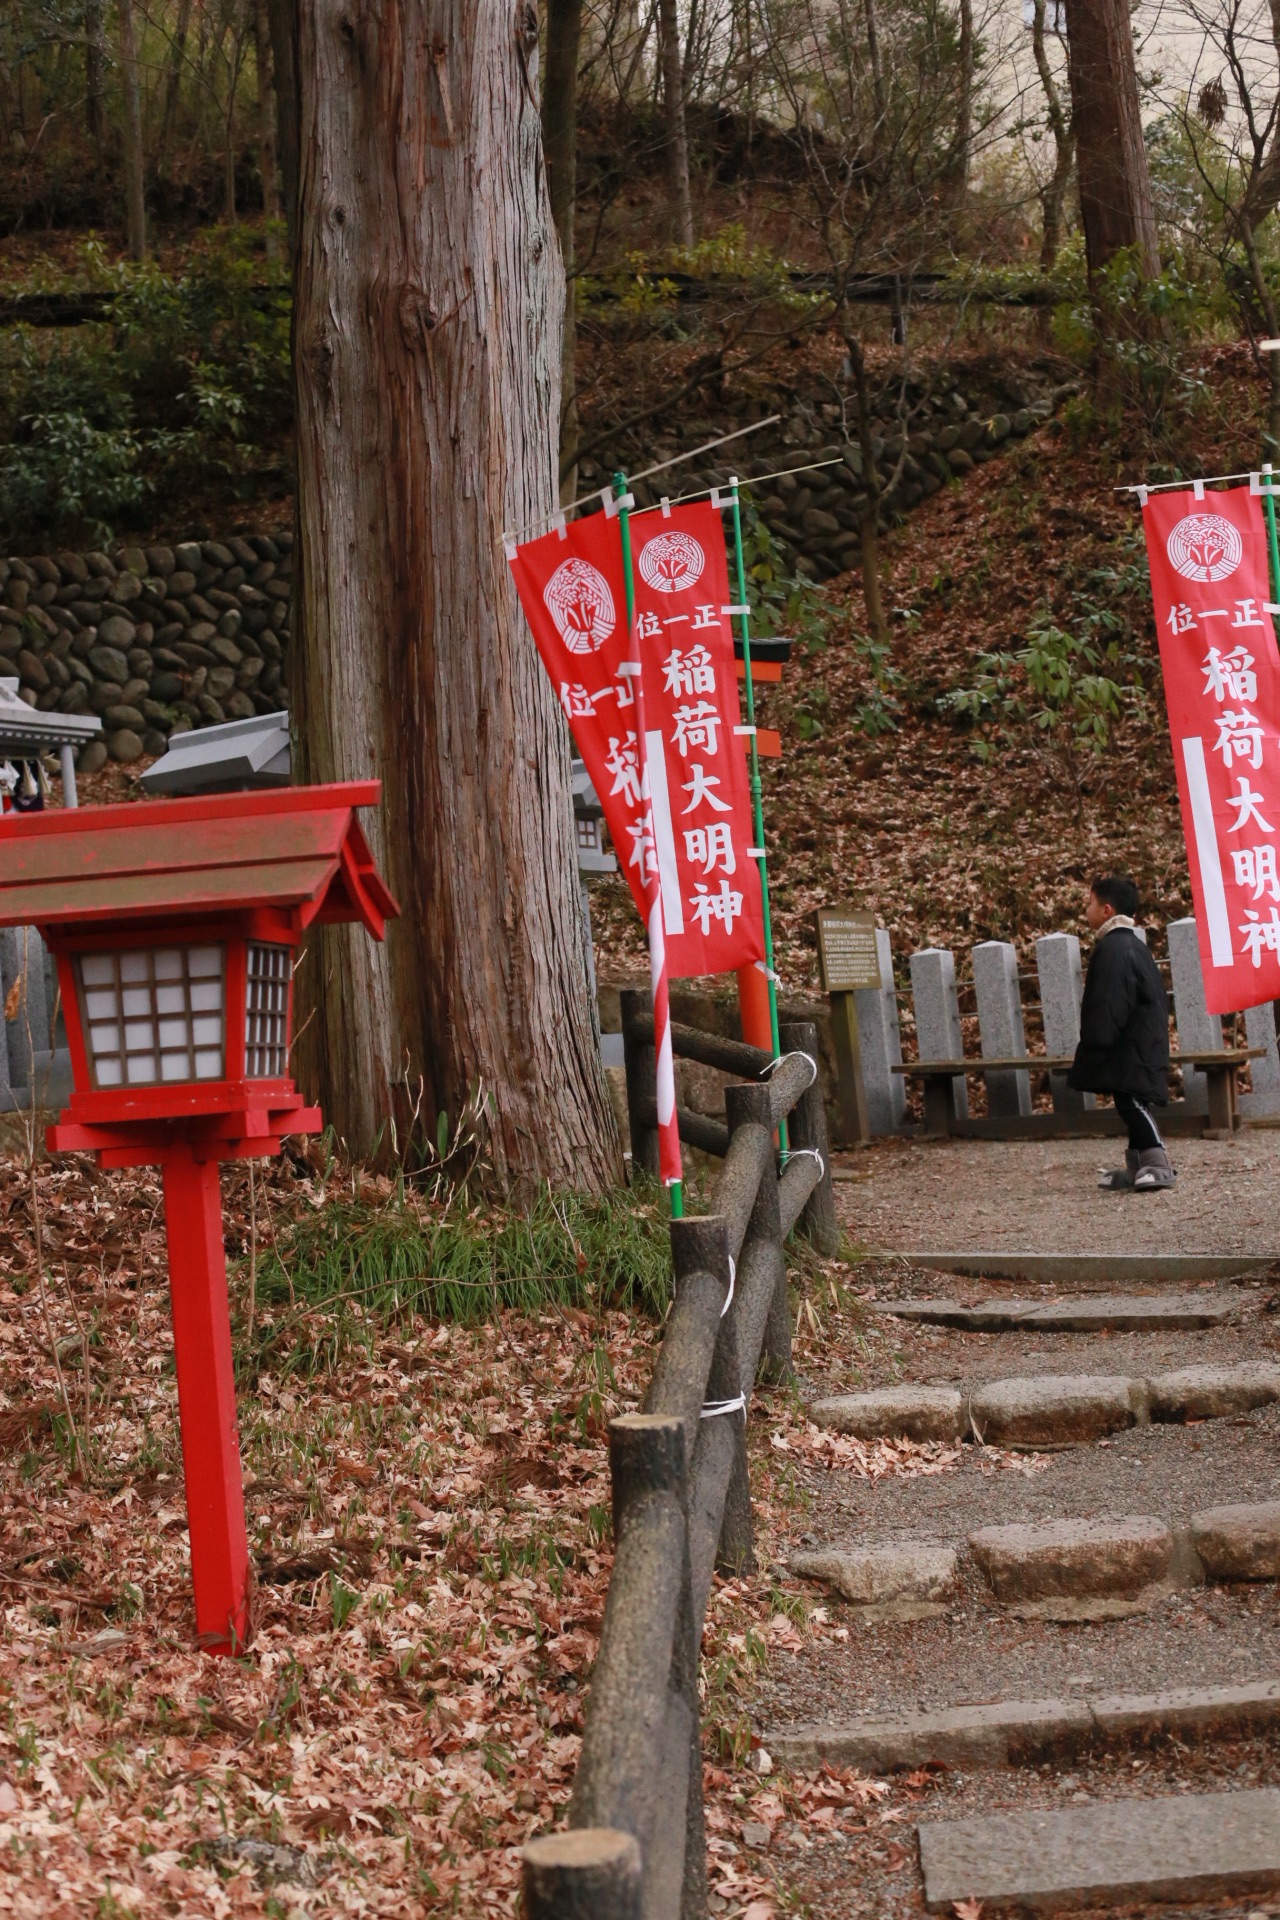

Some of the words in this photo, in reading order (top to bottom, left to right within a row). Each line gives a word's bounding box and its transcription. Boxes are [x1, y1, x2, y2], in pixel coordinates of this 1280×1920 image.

[662, 644, 743, 936] 稲荷大明神
